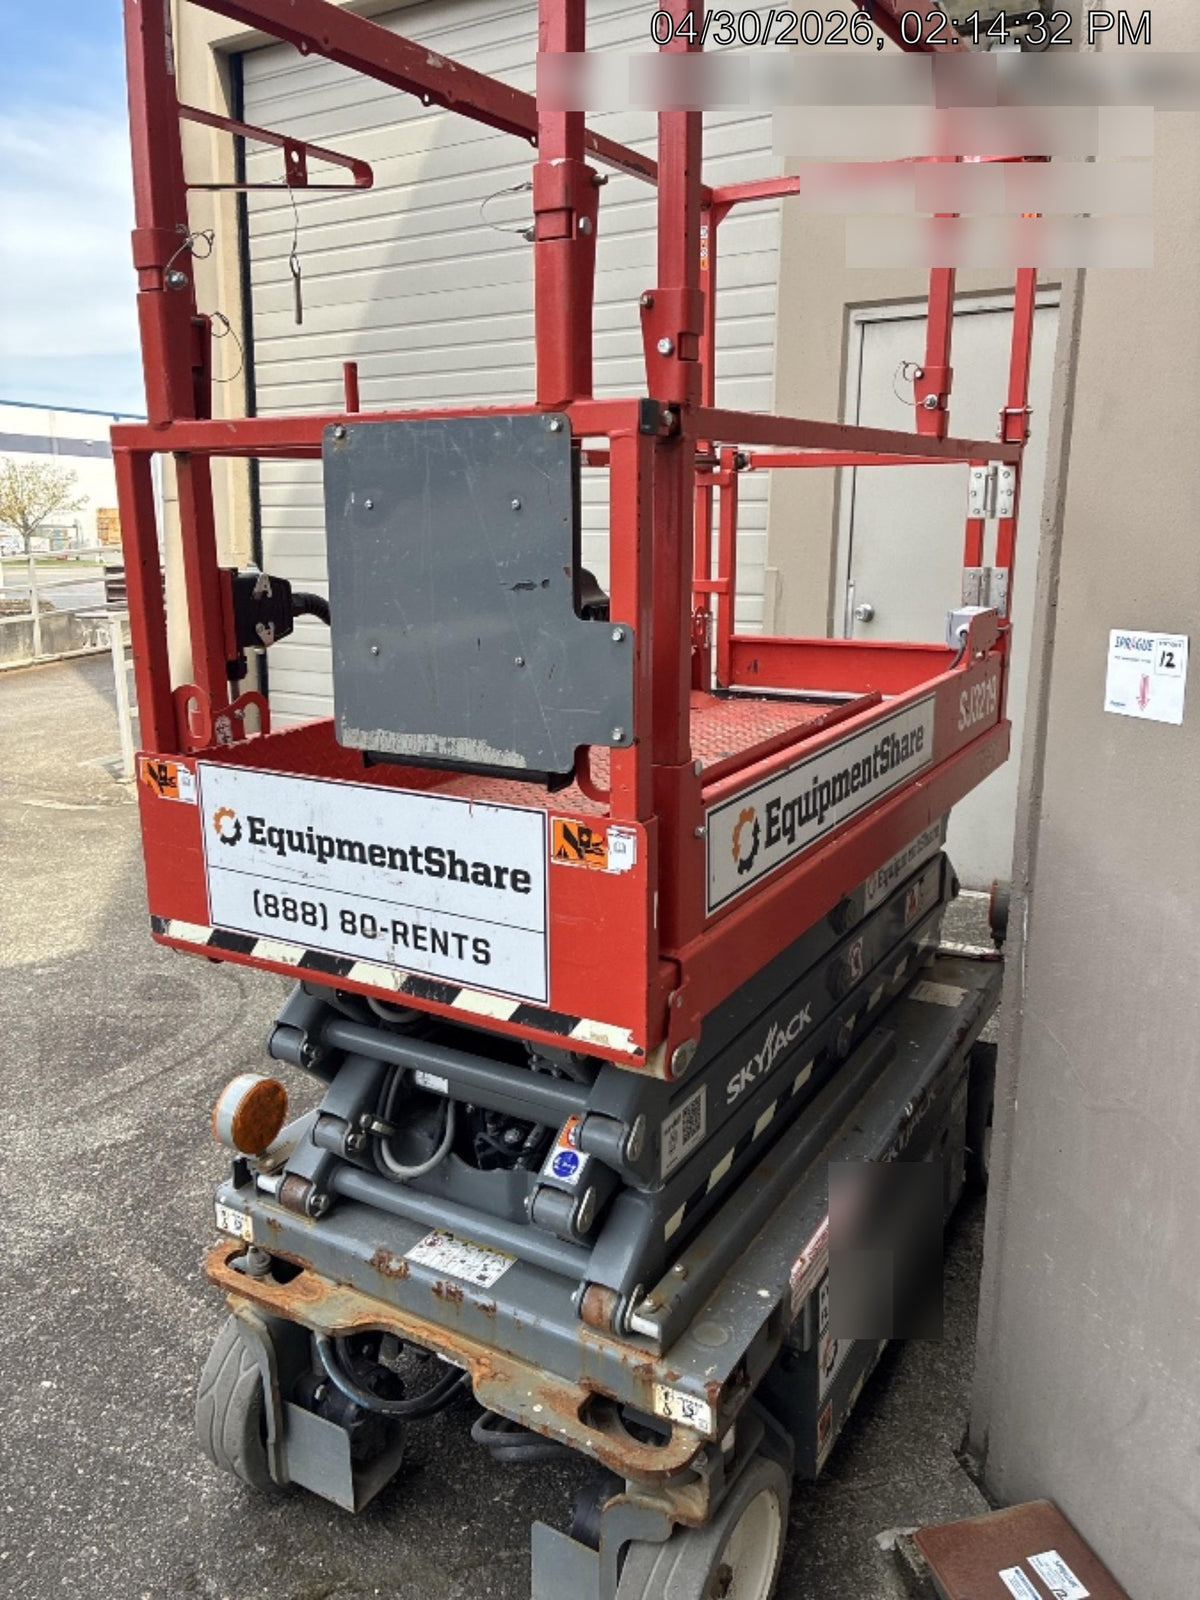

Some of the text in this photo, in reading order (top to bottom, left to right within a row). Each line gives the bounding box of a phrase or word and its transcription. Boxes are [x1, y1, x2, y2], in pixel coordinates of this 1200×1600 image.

[1158, 650, 1176, 669] 12
[764, 724, 925, 848] EquipmentShare
[247, 815, 533, 895] EquipmentShare
[253, 890, 492, 967] (888) 80-RENTS
[726, 1001, 812, 1105] SKYJACK
